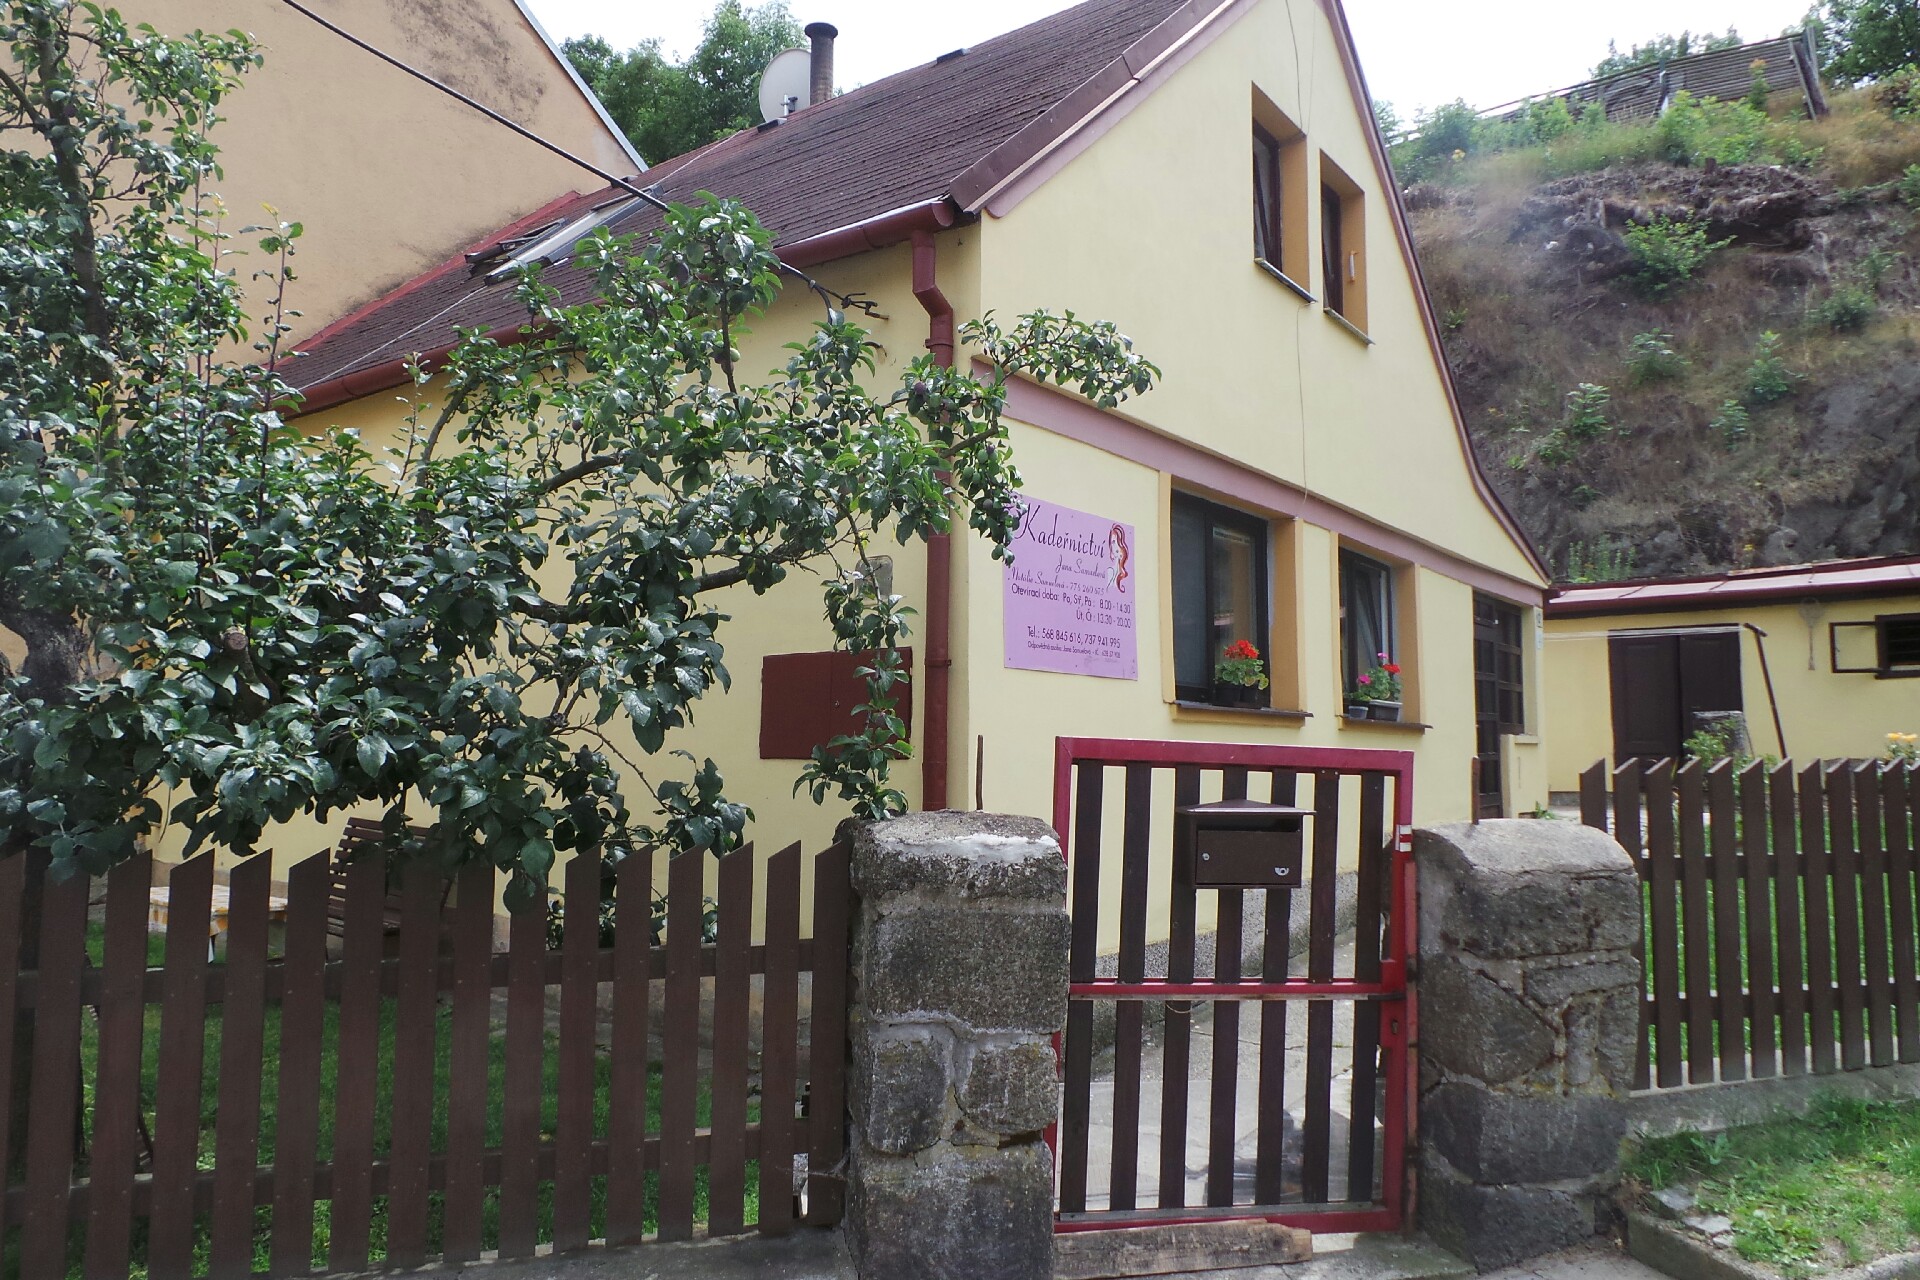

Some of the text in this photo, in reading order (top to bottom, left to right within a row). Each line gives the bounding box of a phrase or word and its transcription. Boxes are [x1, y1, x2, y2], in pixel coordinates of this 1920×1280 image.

[1014, 503, 1105, 558] Kadeřnictví
[1042, 628, 1054, 640] 568
[1056, 630, 1068, 641] 845
[1084, 634, 1096, 645] 737
[1098, 636, 1108, 646] 941
[1110, 638, 1120, 648] 995
